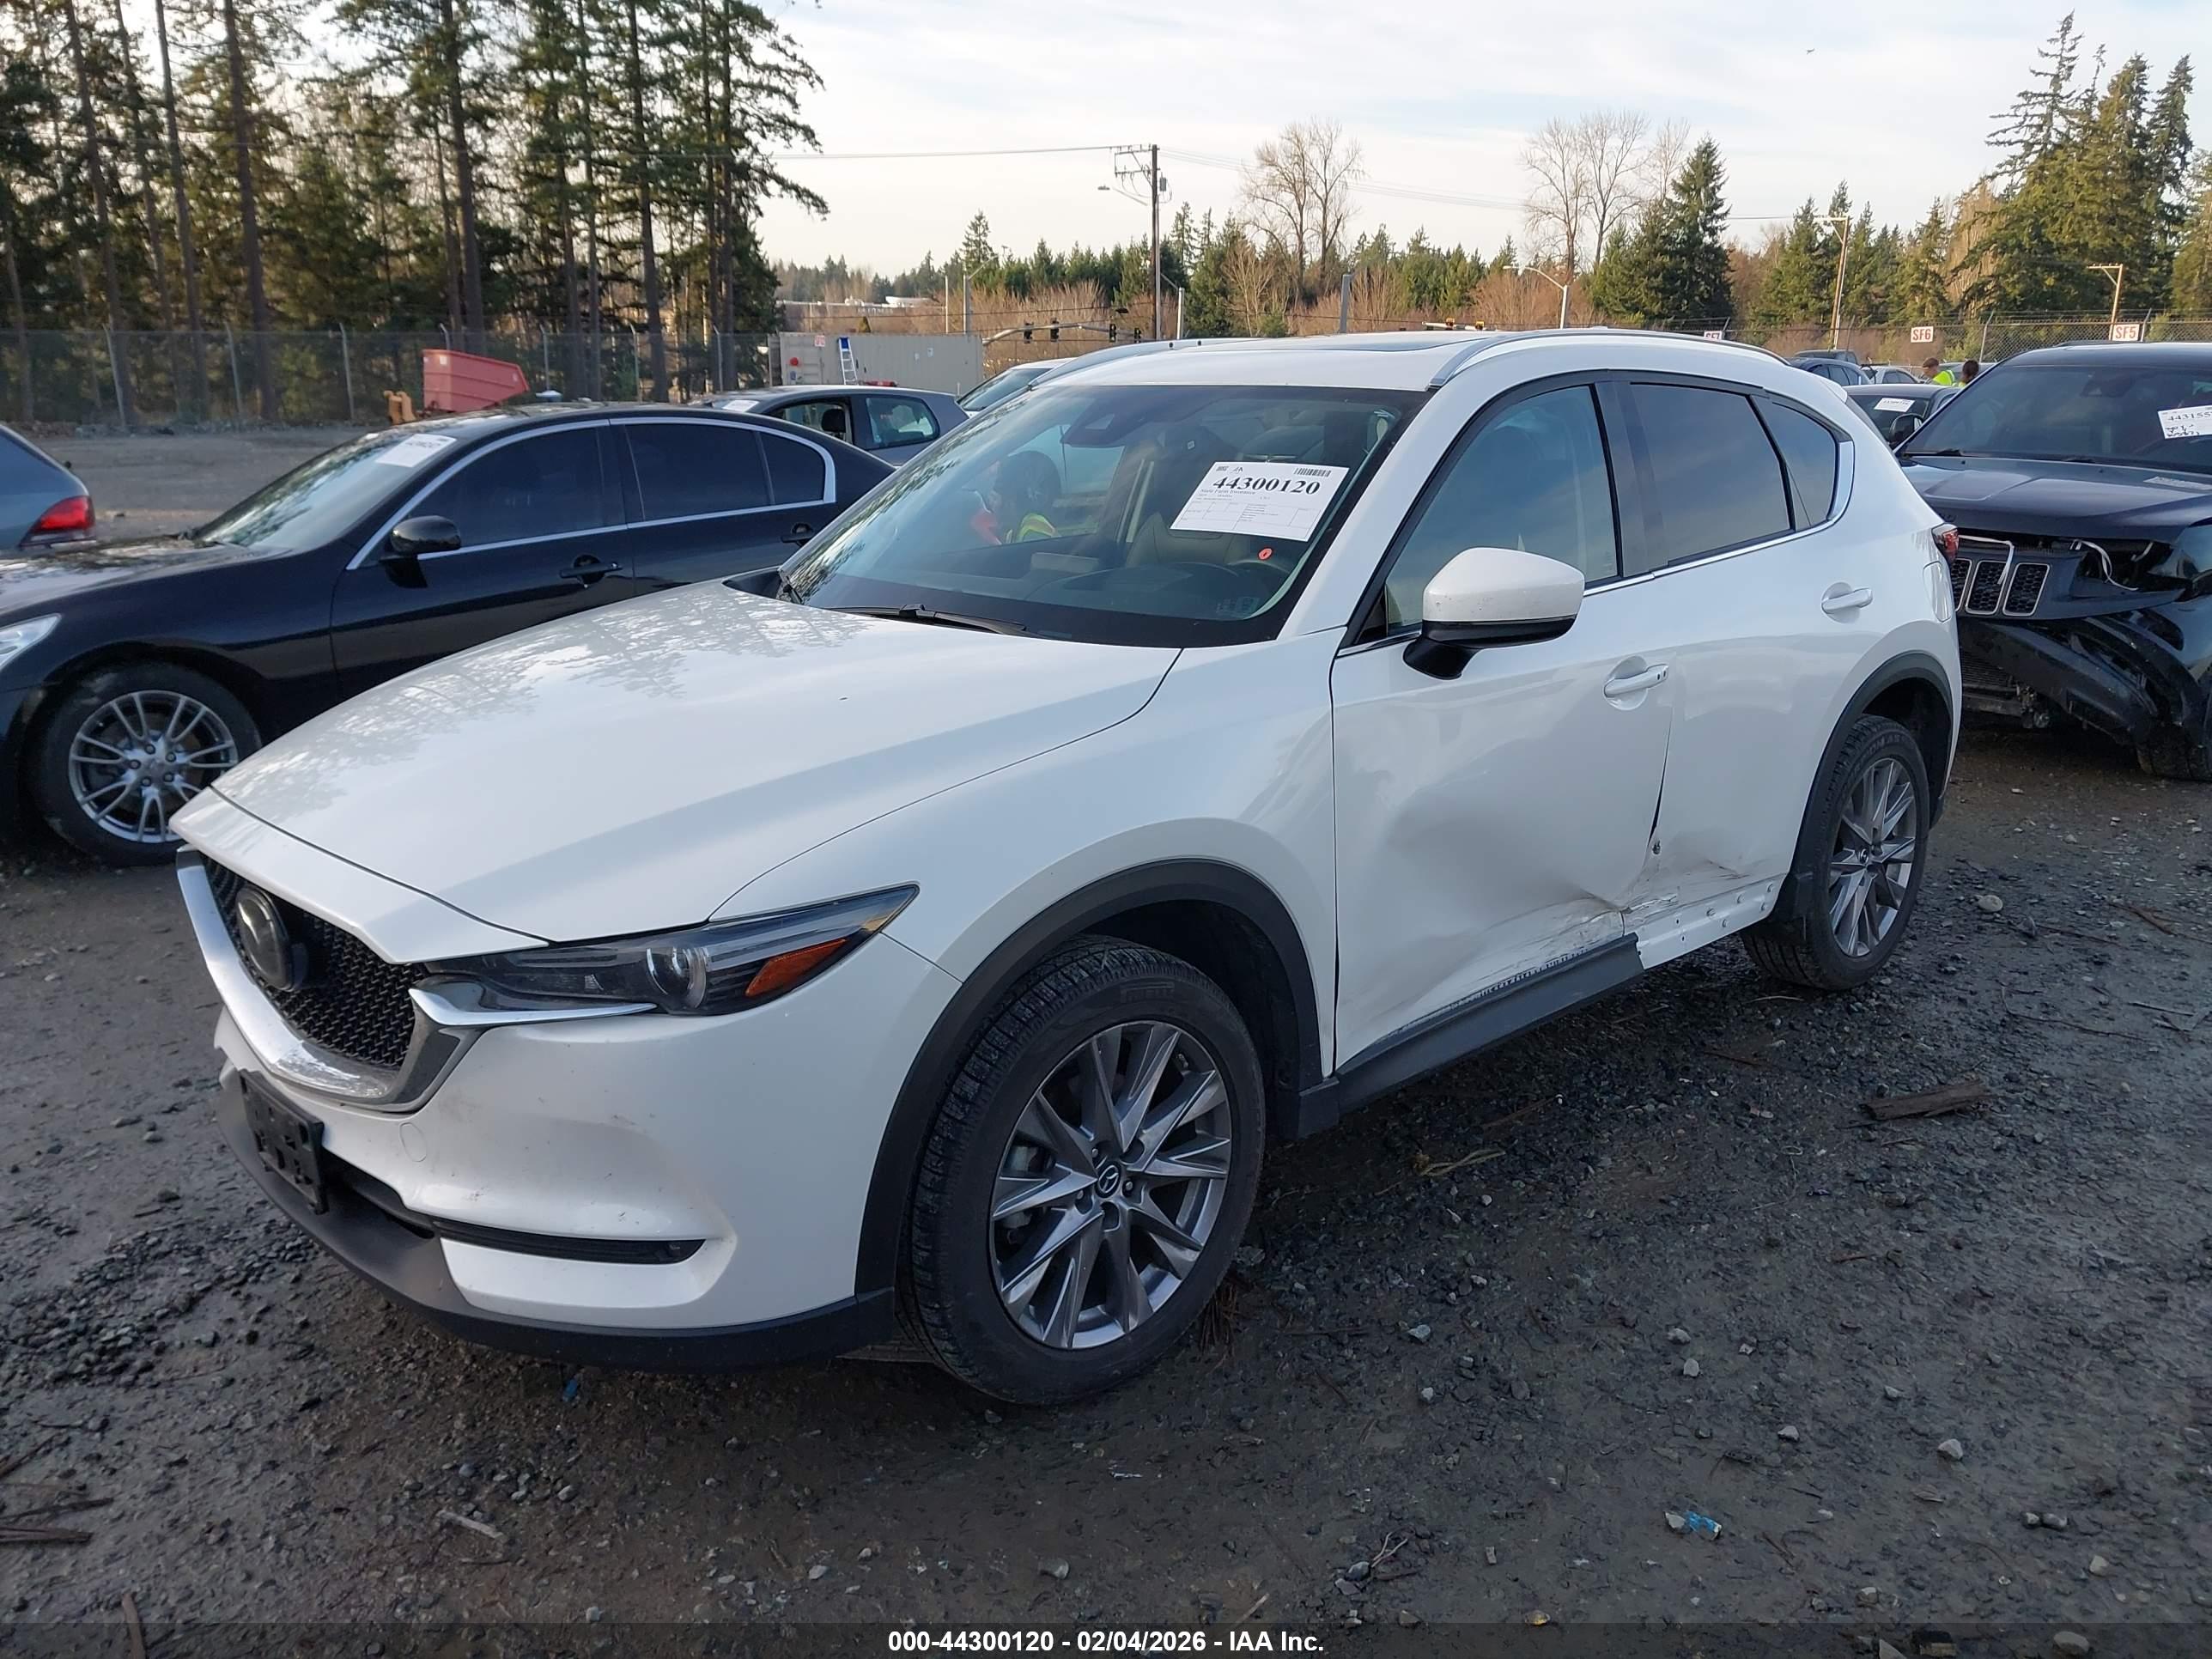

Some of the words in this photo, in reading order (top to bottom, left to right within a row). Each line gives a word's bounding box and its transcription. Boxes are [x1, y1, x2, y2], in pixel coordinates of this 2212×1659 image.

[1912, 328, 1931, 341] SF6
[2115, 325, 2137, 339] SF5
[2167, 411, 2212, 421] 443155
[1212, 476, 1321, 495] 44300120
